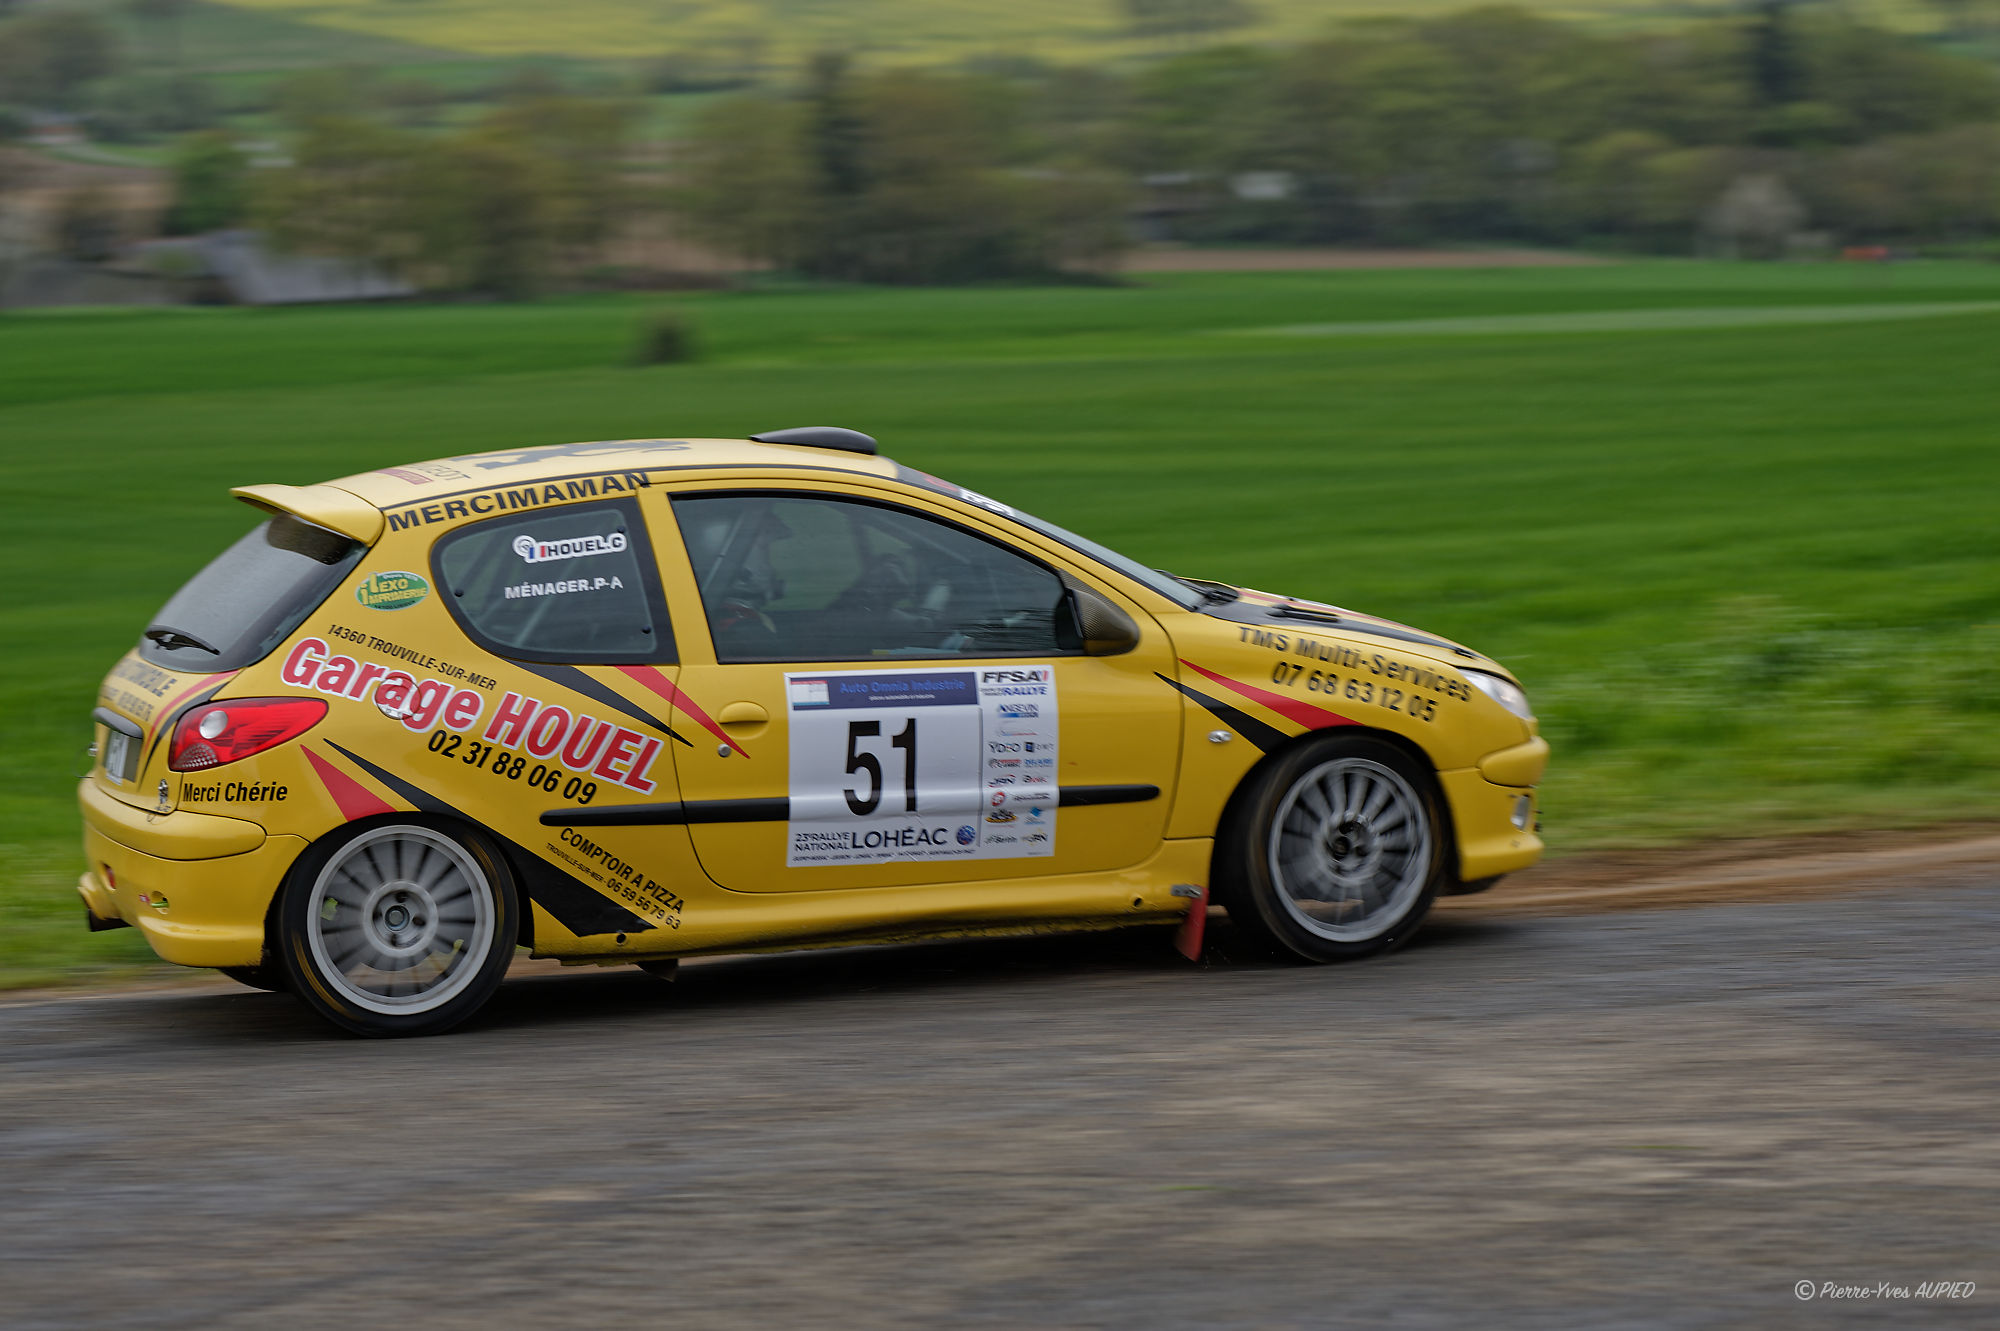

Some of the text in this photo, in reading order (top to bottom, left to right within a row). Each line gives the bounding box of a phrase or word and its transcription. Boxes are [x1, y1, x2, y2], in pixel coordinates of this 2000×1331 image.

[387, 472, 652, 533] MERCIMAMAN
[504, 576, 624, 599] MÉNAGER.P-A
[328, 624, 497, 691] 14360 TROUVILLE-SUR-MER
[840, 679, 966, 693] Auto Omnia Industrie
[983, 671, 1041, 683] FFSA
[1239, 626, 1473, 702] TMS Multi-Services
[281, 638, 484, 733] Garage
[483, 691, 663, 795] HOUEL
[1272, 661, 1439, 723] 07 68 63 12 05
[183, 781, 287, 802] Merci Chérie
[428, 730, 597, 804] 02 31 88 06 09
[843, 718, 918, 816] 51
[796, 826, 948, 852] NATIONAL LOHÉAC
[560, 827, 685, 914] COMPTOIR A PIZZA
[606, 878, 621, 893] 06
[621, 887, 637, 901] 59
[636, 896, 650, 911] 56
[650, 905, 665, 920] 79
[665, 915, 681, 930] 63
